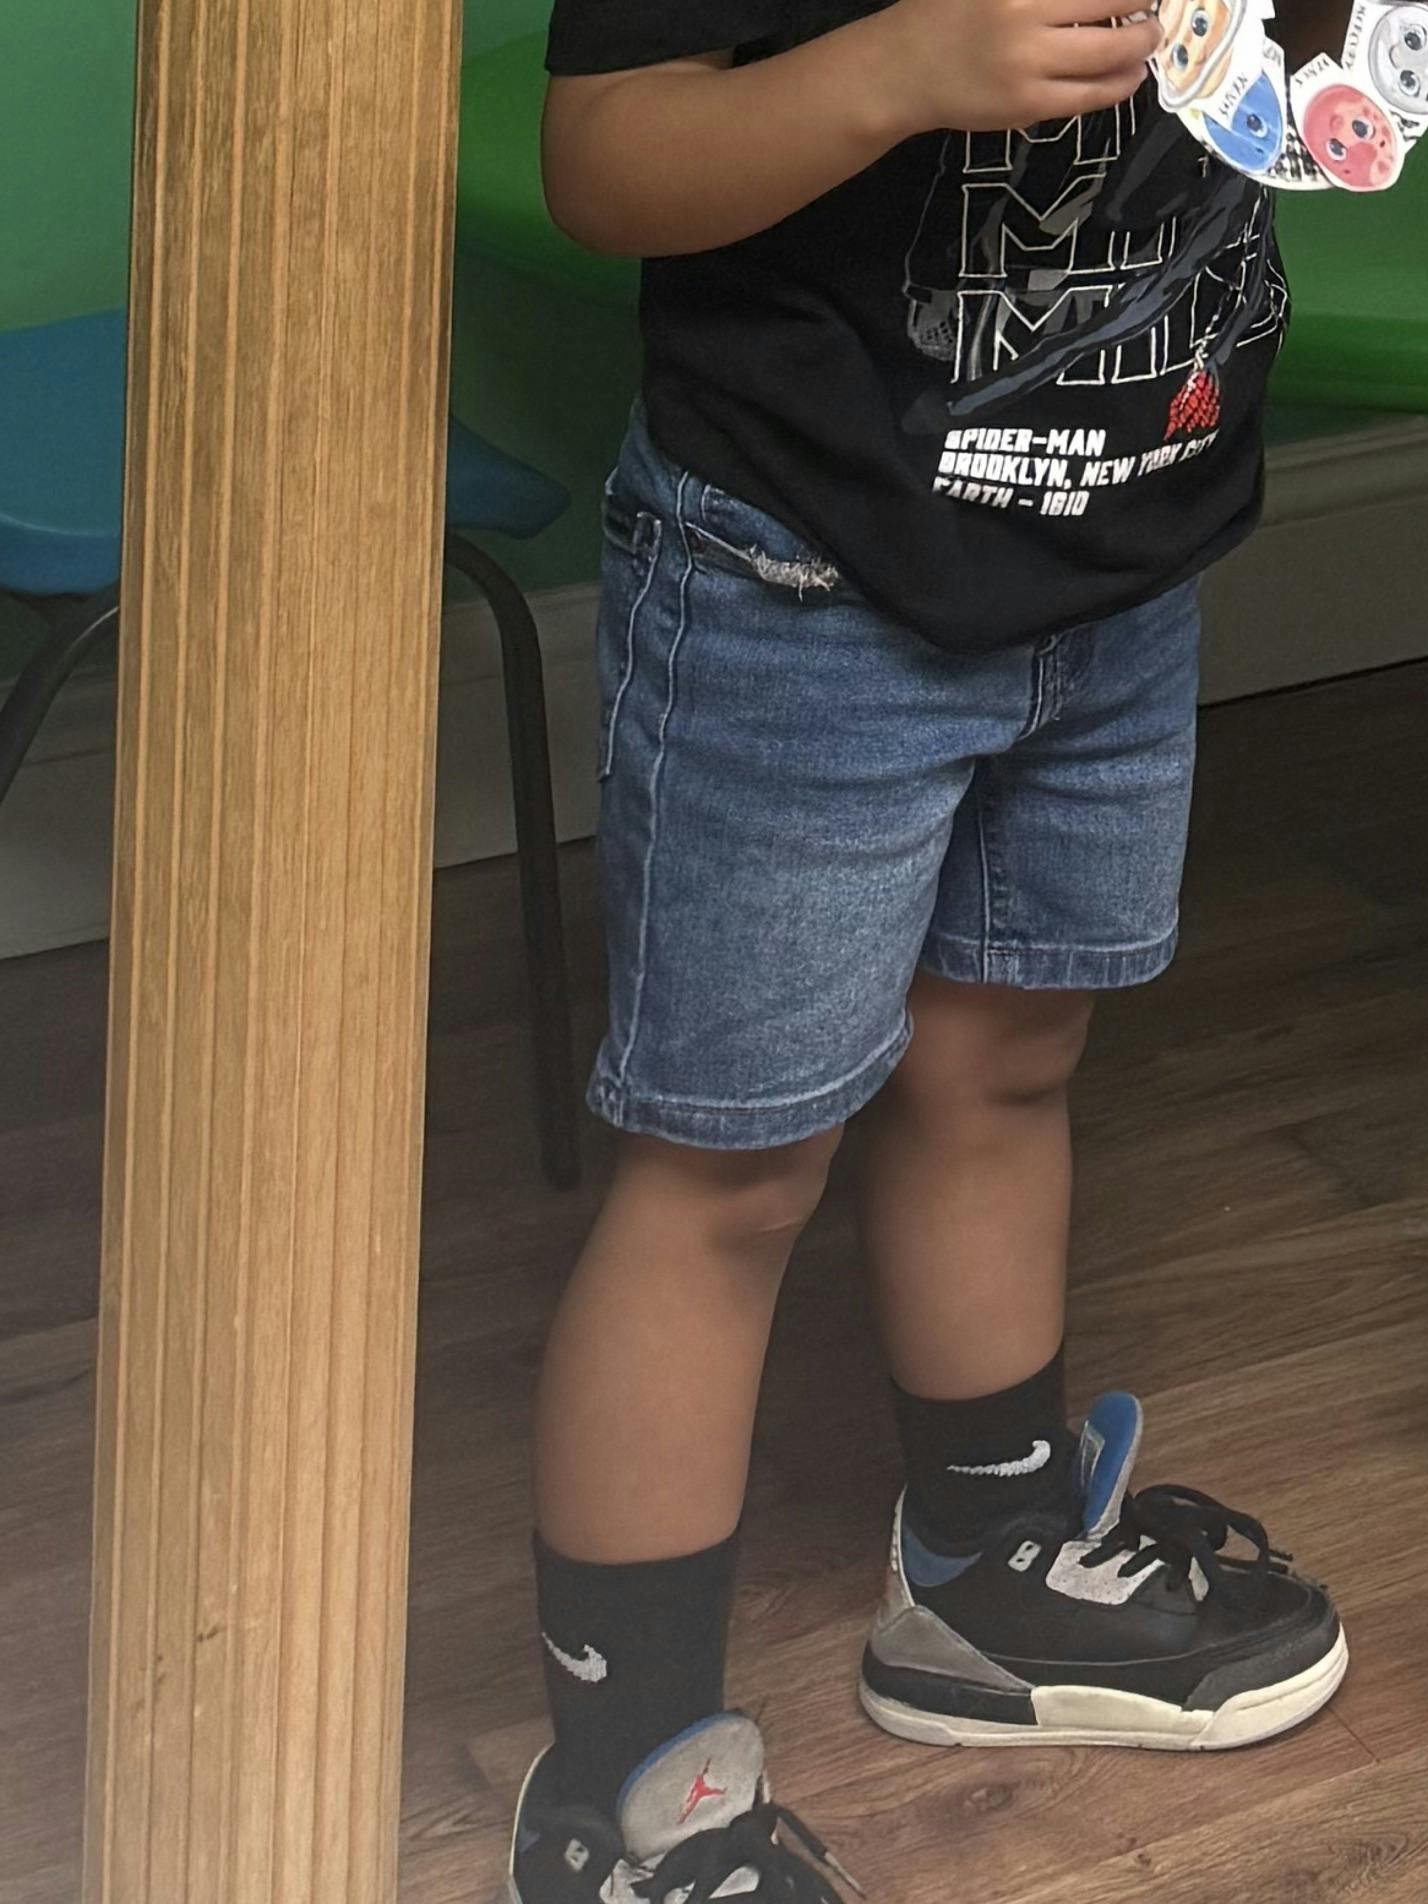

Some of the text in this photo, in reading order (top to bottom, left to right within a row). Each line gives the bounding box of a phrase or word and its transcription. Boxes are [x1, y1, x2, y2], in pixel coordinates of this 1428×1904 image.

[944, 428, 1107, 458] SPIDER-MAN
[937, 449, 1073, 490] BROOKLYN,
[1079, 456, 1136, 488] NEW
